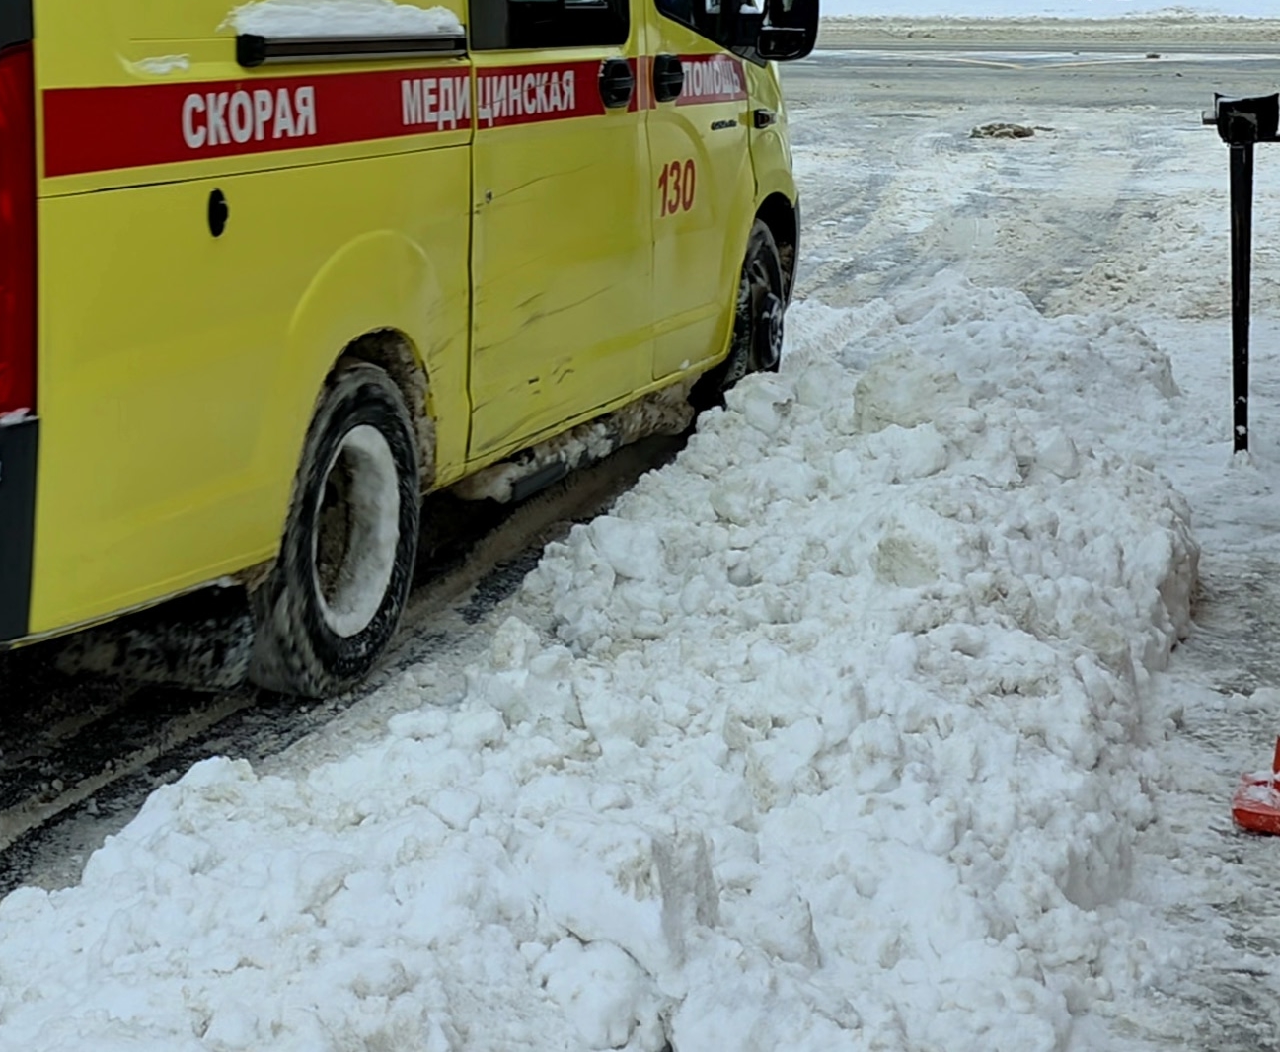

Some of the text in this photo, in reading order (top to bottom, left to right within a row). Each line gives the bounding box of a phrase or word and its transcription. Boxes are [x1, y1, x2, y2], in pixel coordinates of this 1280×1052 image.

[182, 60, 741, 148] СКОРАЯ МЕДИЦИНСКАЯ ПОМОЩЬ
[658, 159, 696, 218] 130
